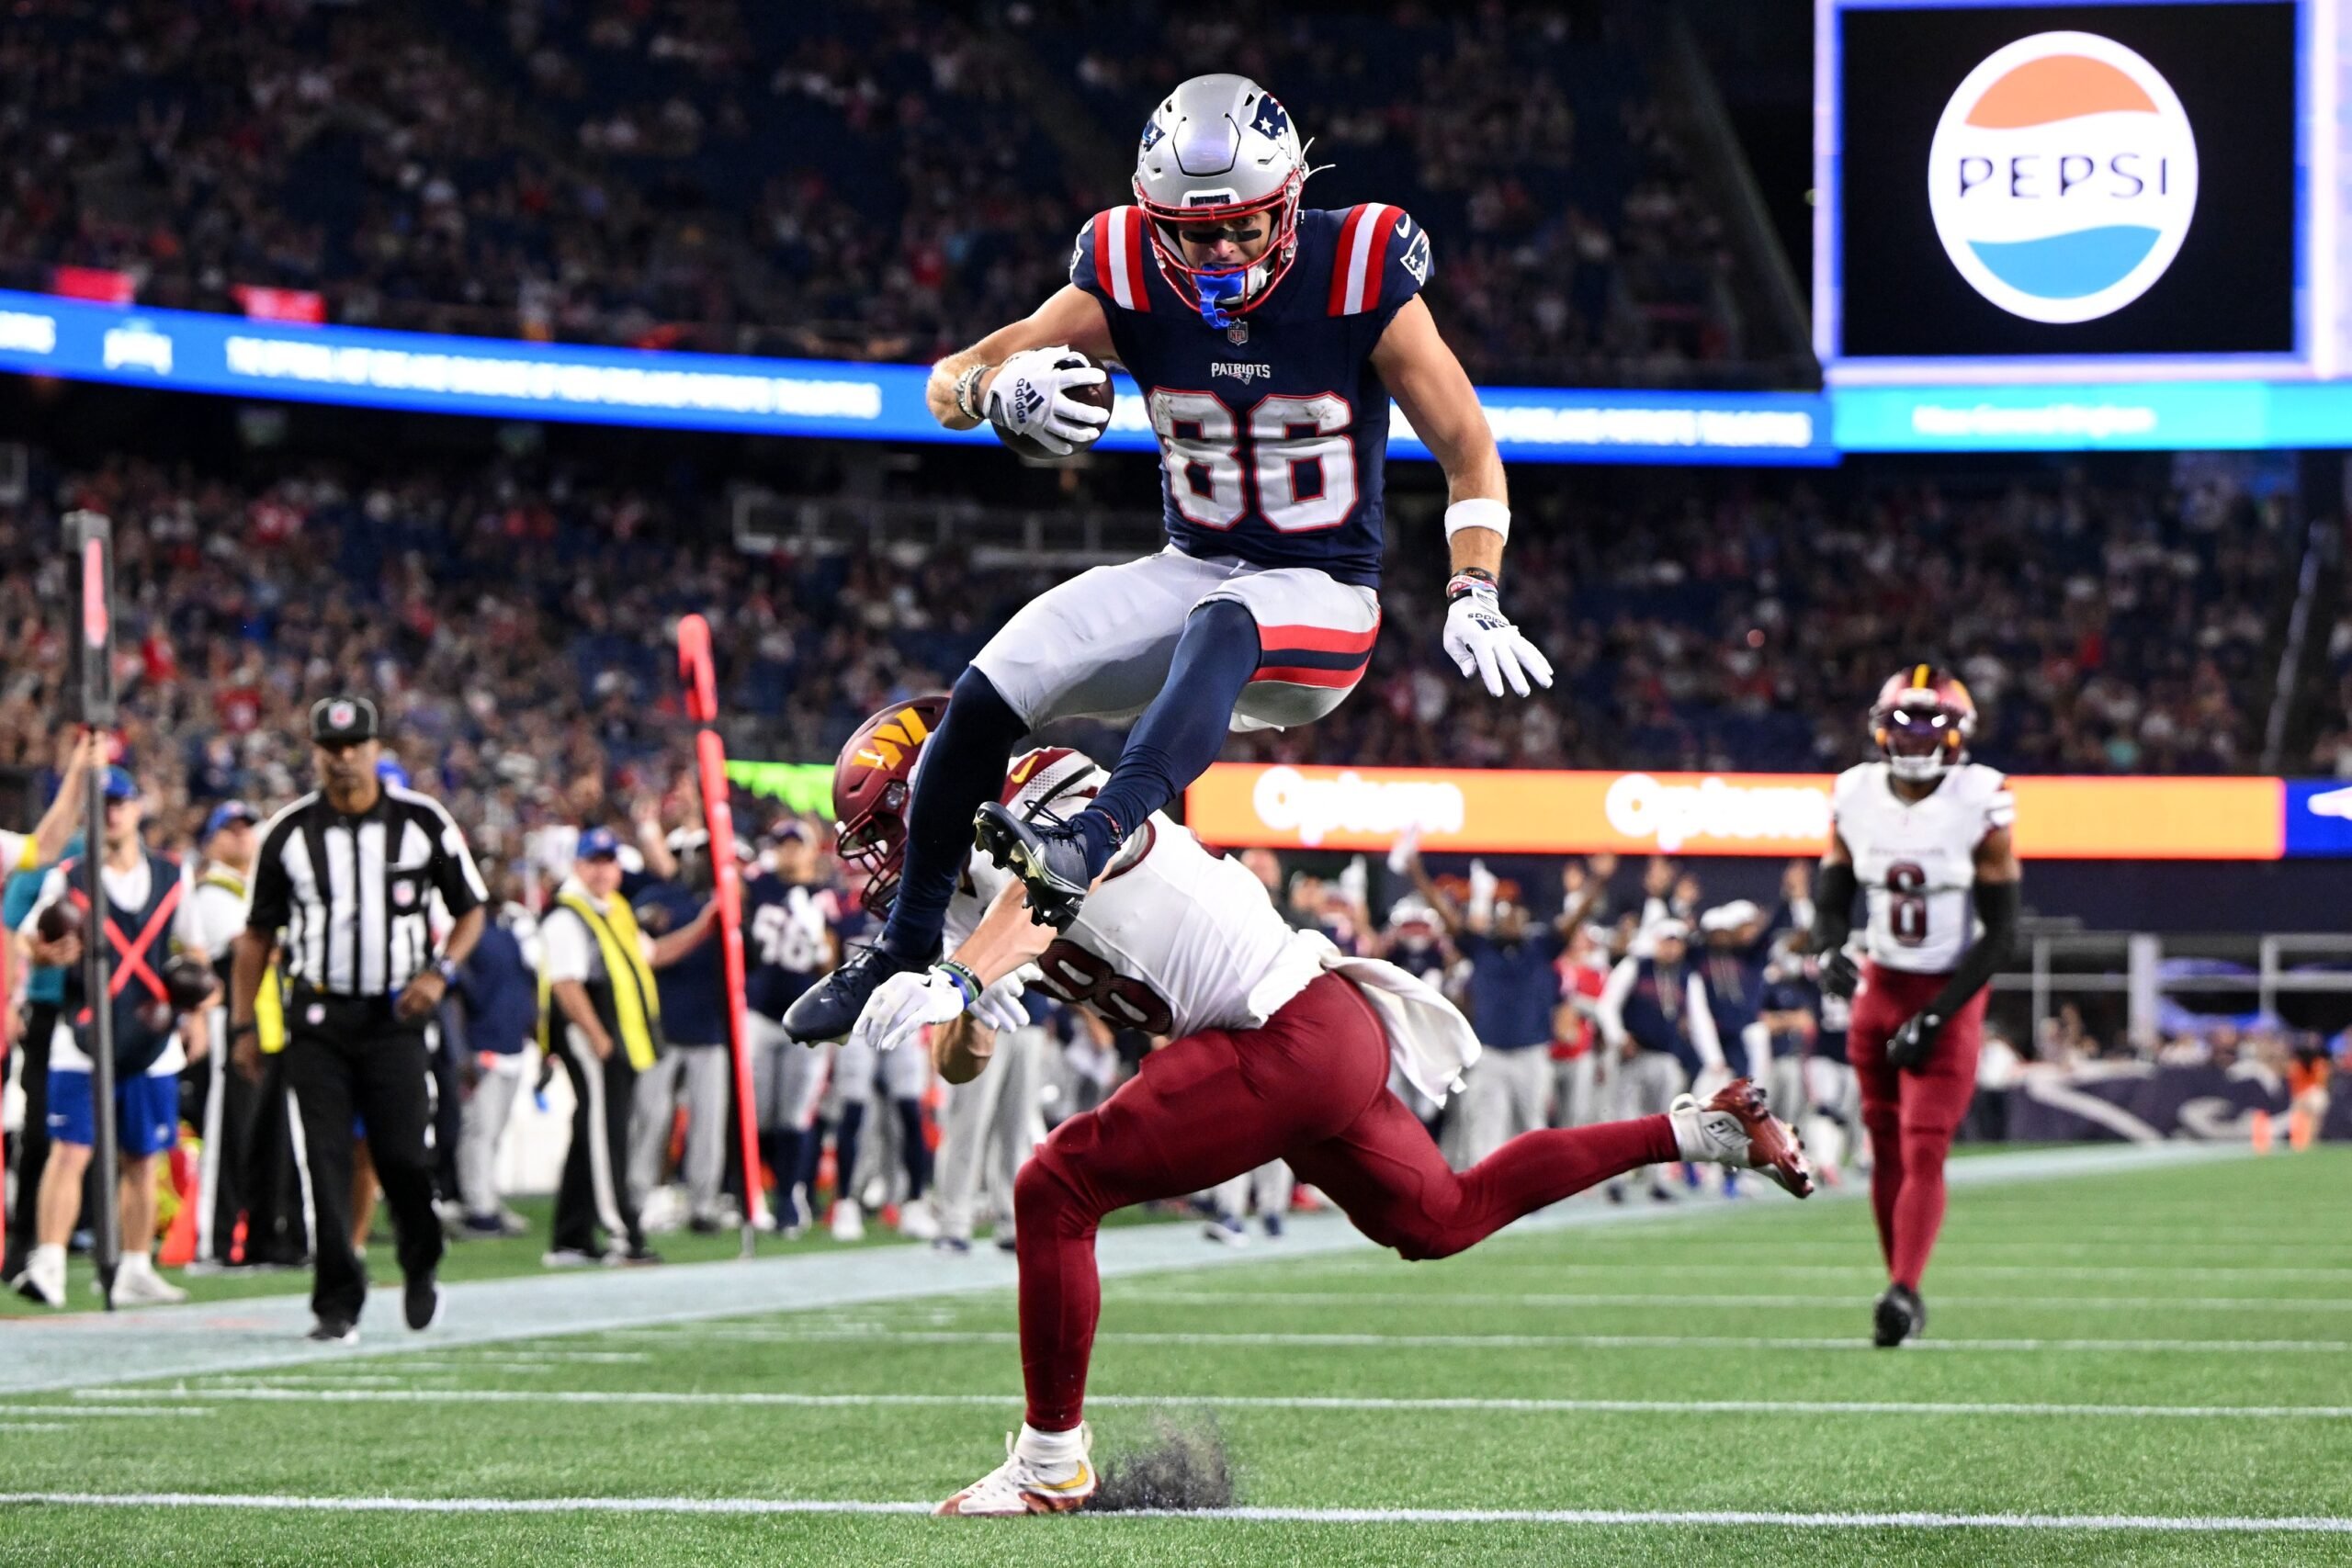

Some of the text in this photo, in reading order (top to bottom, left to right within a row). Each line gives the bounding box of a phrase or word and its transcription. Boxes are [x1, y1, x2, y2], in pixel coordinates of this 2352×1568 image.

[1959, 152, 2167, 198] PEPSI
[1211, 362, 1271, 378] PATRIOTS
[1015, 378, 1026, 424] adidas
[1148, 385, 1359, 533] 86
